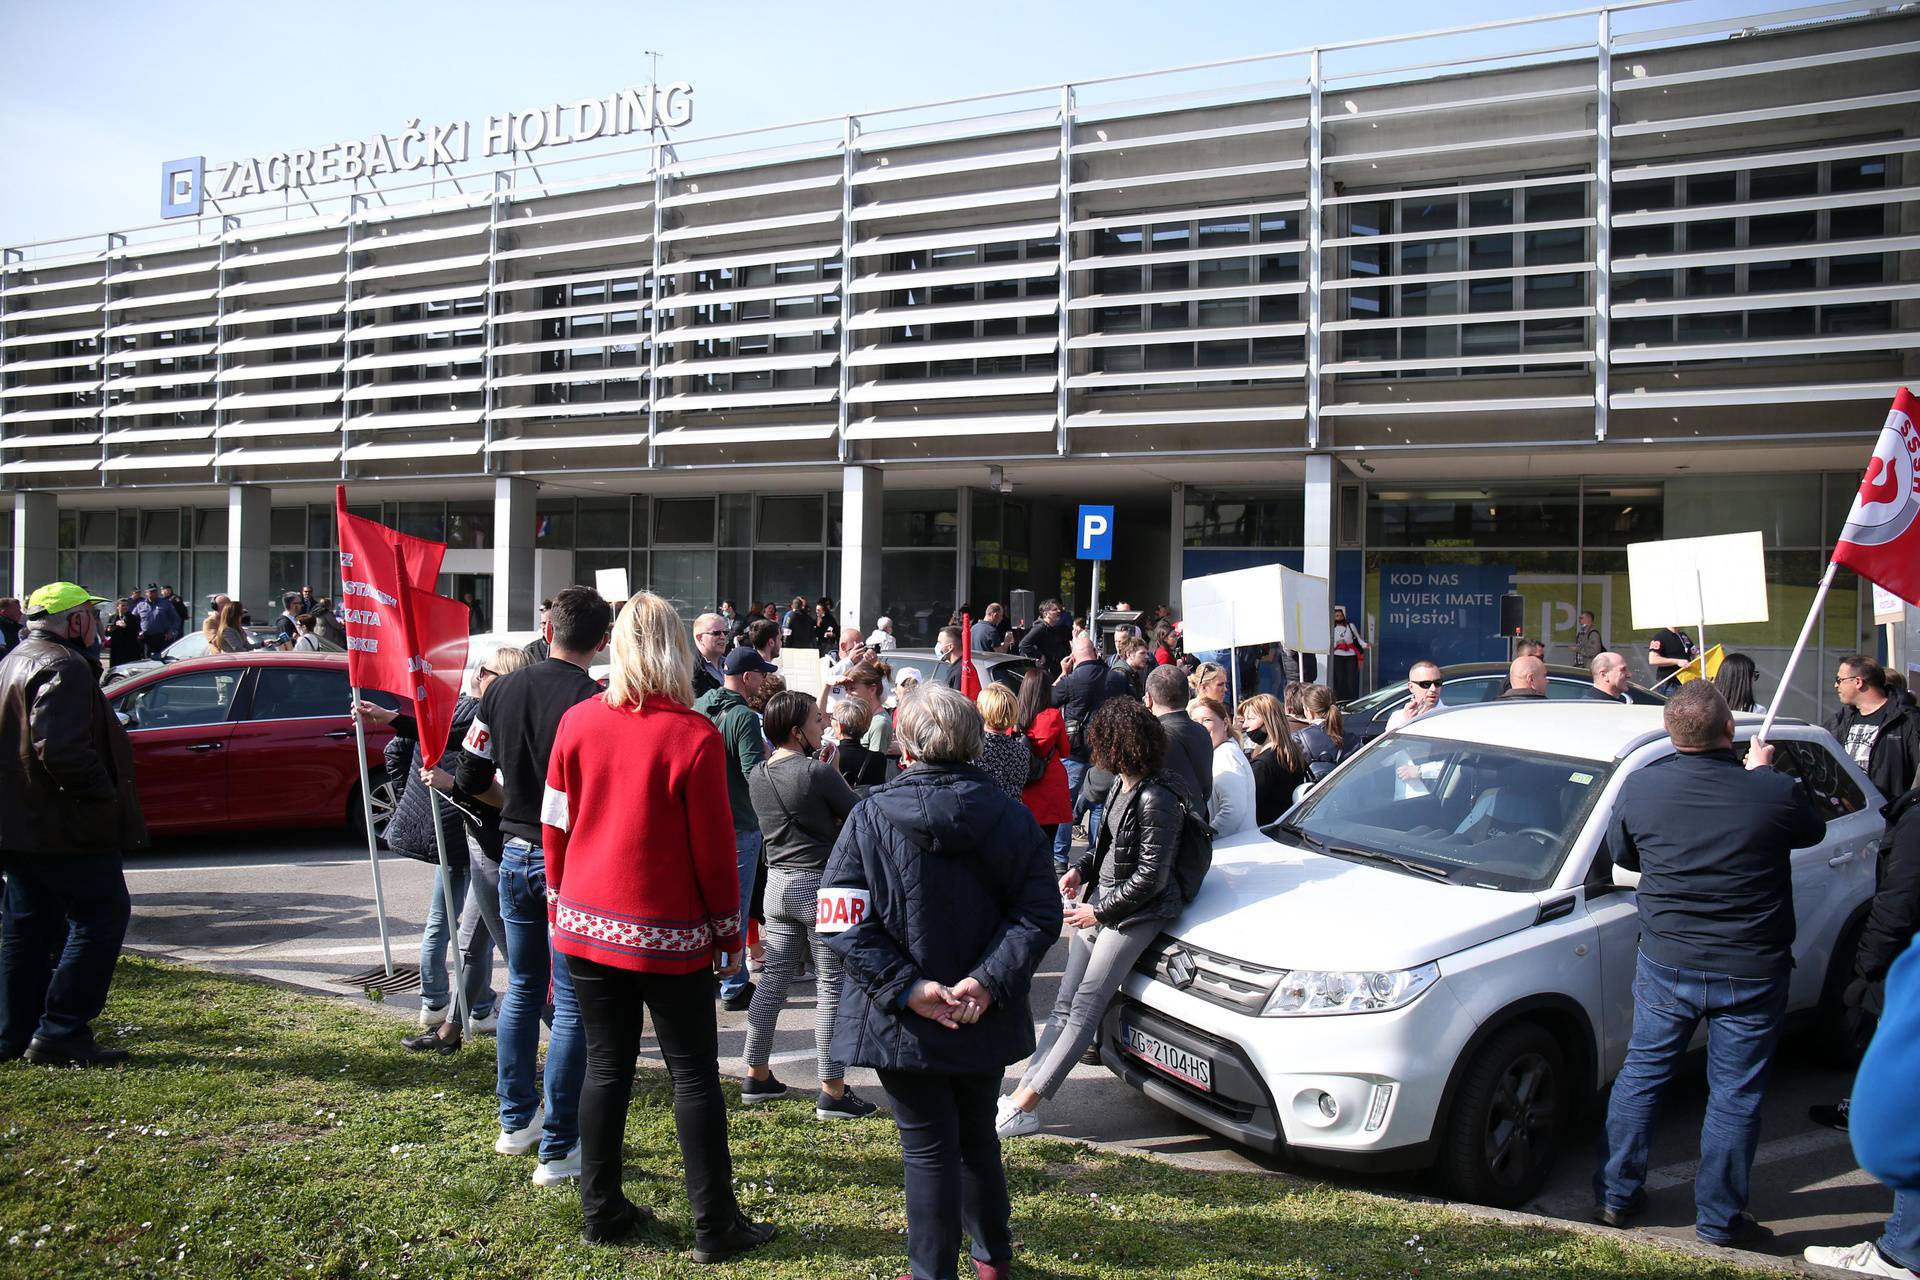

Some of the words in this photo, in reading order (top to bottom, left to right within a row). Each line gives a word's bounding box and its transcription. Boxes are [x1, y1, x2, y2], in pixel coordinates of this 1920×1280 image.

[214, 118, 470, 200] ZAGREBAČKI
[483, 80, 693, 157] HOLDING
[1083, 515, 1107, 549] P
[1390, 574, 1423, 585] KOD
[1428, 574, 1459, 585] NAS
[1390, 593, 1441, 606] UVIJEK
[1445, 594, 1493, 606] IMATE
[1390, 608, 1455, 629] mjesto!
[816, 898, 865, 925] DAR
[1129, 1027, 1146, 1053] ZG
